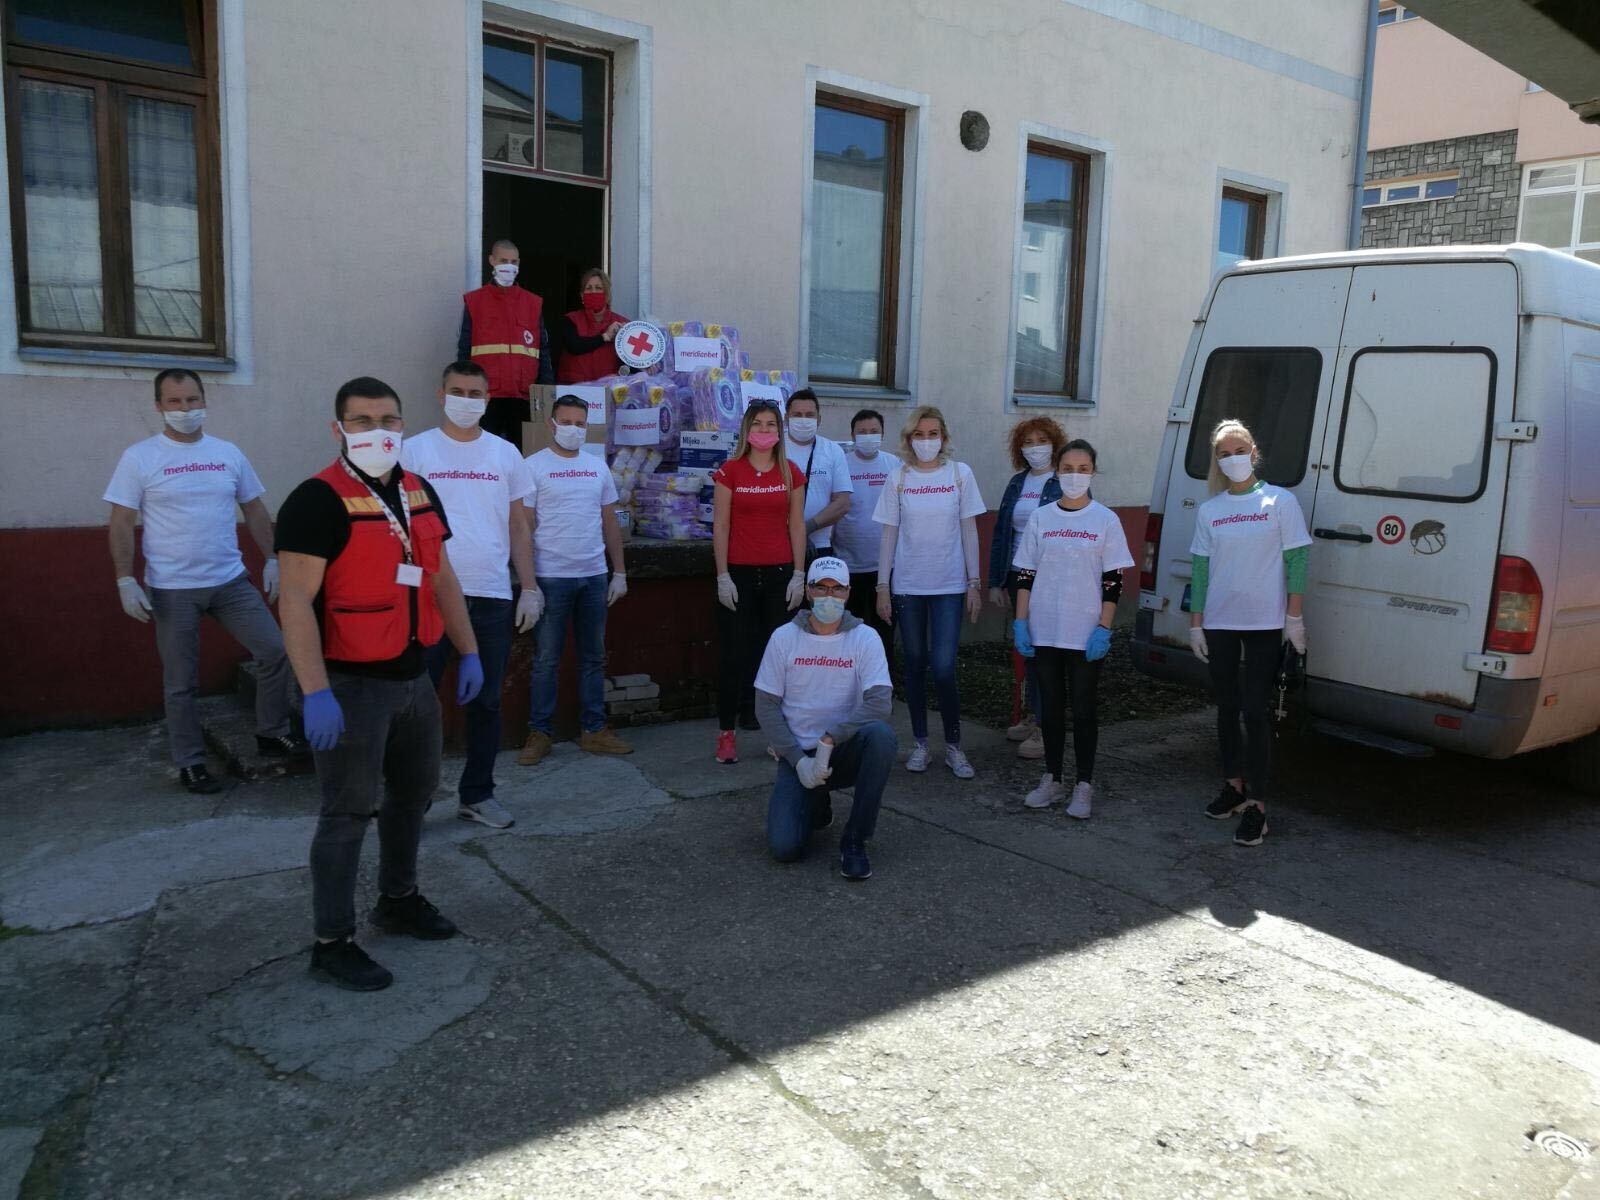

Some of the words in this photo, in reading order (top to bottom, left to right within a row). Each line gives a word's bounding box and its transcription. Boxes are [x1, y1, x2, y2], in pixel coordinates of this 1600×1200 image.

[680, 350, 718, 359] meridianbet
[621, 422, 657, 431] meridianbet
[163, 463, 225, 476] meridianbet
[549, 470, 598, 478] meridianbet
[428, 470, 500, 481] meridianbet.ba
[850, 472, 888, 481] meridianbe
[735, 484, 788, 494] meridianbet.b
[903, 485, 955, 495] meridianbet
[1212, 512, 1269, 527] meridianbet
[1042, 529, 1098, 541] meridianbet
[1384, 524, 1398, 536] 80
[794, 656, 853, 668] meridianbet
